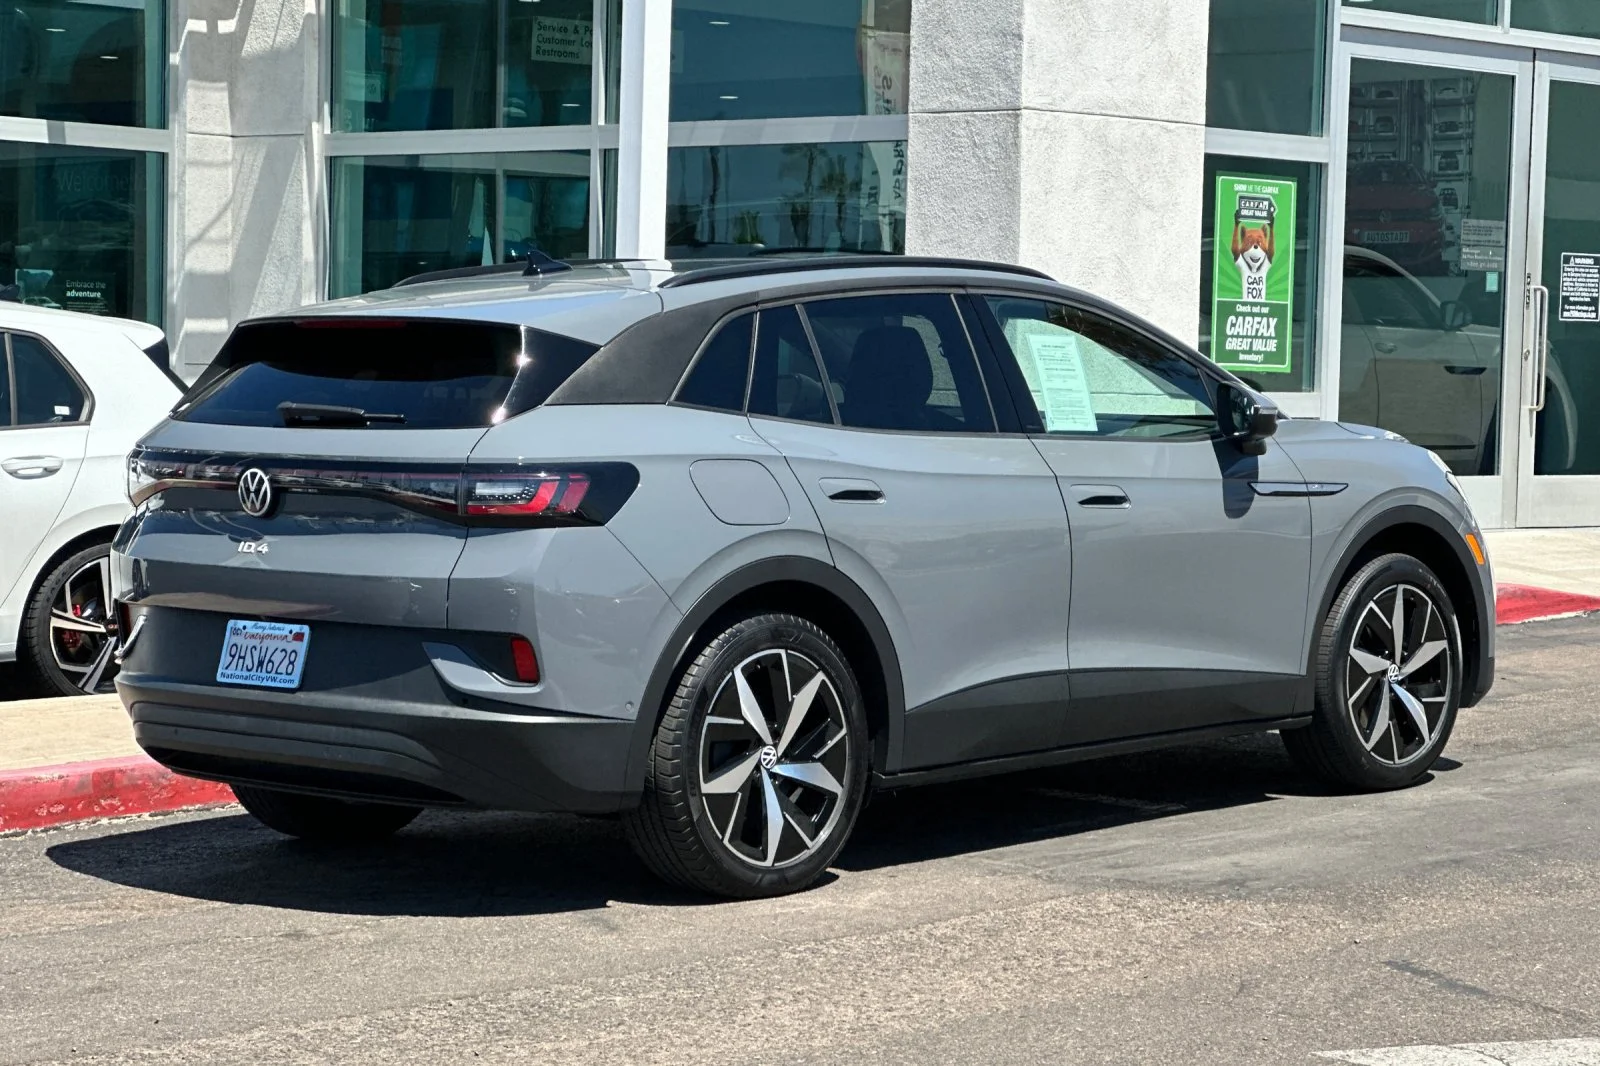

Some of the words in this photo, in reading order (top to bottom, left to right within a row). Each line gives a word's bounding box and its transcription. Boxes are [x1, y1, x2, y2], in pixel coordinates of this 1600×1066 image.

[537, 21, 568, 33] Service
[573, 24, 579, 35] &
[536, 33, 576, 46] Customer
[535, 45, 580, 59] Restrooms
[1233, 183, 1247, 192] SHOW
[1261, 186, 1279, 194] CARFAX
[1366, 232, 1409, 242] AUTOSTADT
[66, 280, 94, 289] Embrace
[95, 280, 106, 289] the
[1246, 275, 1264, 286] CAR
[66, 289, 102, 298] adventure
[1246, 287, 1263, 300] FOX
[1236, 303, 1252, 313] Check
[1252, 305, 1261, 313] out
[1261, 306, 1270, 314] our
[1225, 315, 1278, 337] CARFAX
[1225, 337, 1252, 351] GREAT
[1252, 338, 1278, 352] VALUE
[244, 631, 289, 644] California
[225, 643, 298, 676] 9HSW628
[220, 671, 295, 685] NationalCityVW.com
